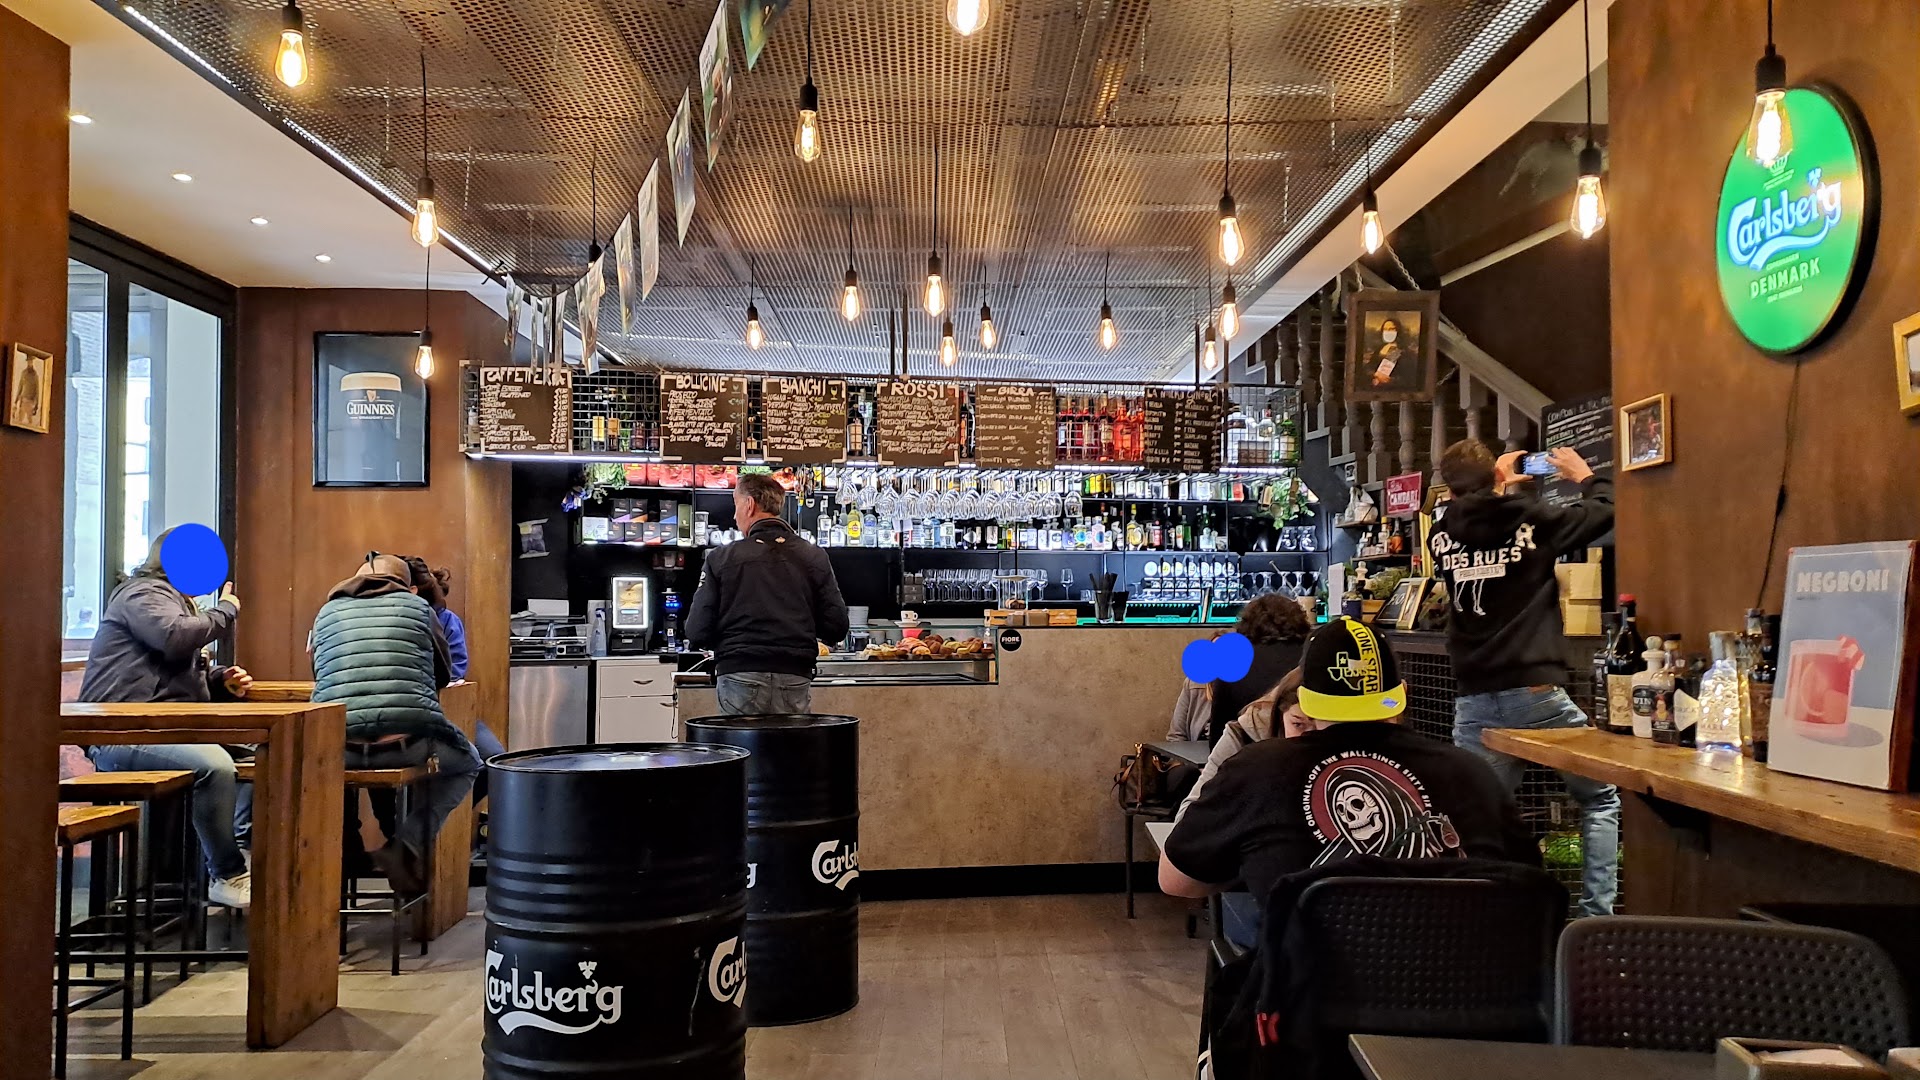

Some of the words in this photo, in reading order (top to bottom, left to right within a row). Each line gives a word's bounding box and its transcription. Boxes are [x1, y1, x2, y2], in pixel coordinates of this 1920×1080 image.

[1727, 169, 1841, 270] Carlsberg
[1750, 256, 1820, 300] DENMARK
[676, 373, 729, 393] BOLLICINE
[780, 378, 826, 396] BIANCHI
[891, 382, 944, 400] ROSSI
[998, 386, 1034, 397] BIRRA
[346, 401, 395, 416] GUINNESS
[1443, 552, 1469, 570] DES
[1473, 546, 1522, 567] RUES
[1797, 569, 1889, 593] NEGRONI
[1352, 627, 1373, 655] LONE
[1366, 657, 1379, 693] STAR
[1313, 829, 1327, 844] THE
[1321, 755, 1338, 766] THE
[1402, 769, 1425, 791] SIXTY
[1422, 794, 1432, 808] SIX
[708, 934, 747, 1008] Carl
[485, 949, 624, 1036] Carlsberg
